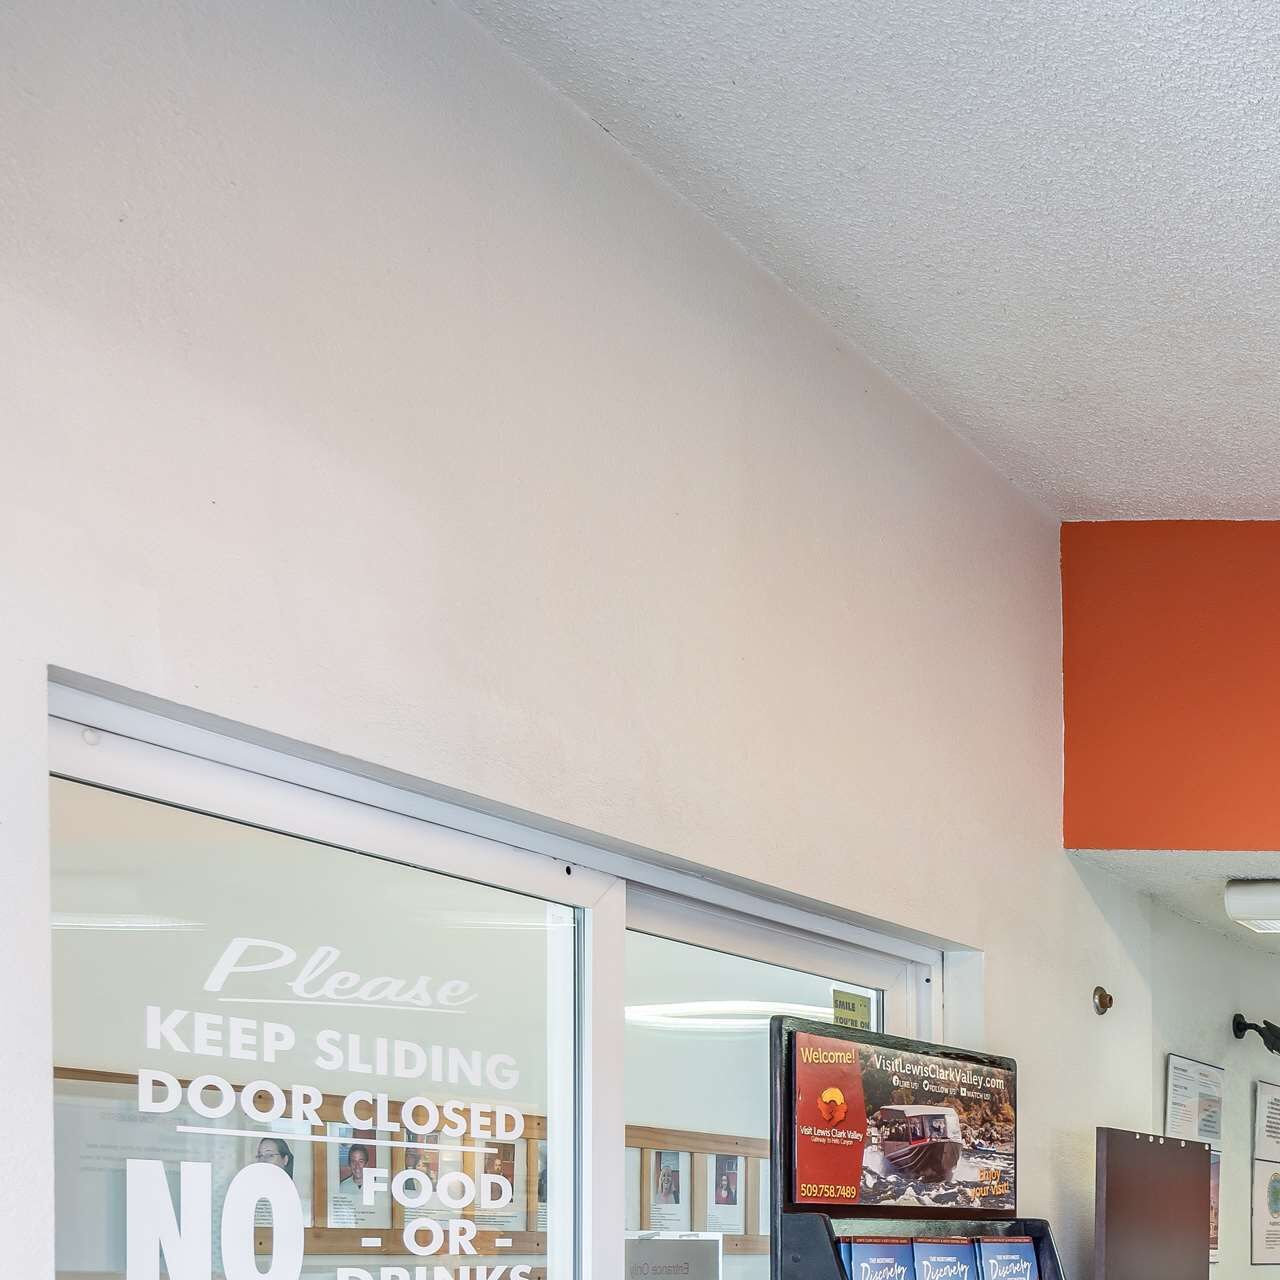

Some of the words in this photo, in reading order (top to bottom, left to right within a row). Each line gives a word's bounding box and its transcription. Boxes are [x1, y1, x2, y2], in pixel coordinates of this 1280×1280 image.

[203, 938, 478, 1006] Please
[834, 1000, 856, 1012] SMILE
[146, 1006, 296, 1064] KEEP
[315, 1030, 520, 1090] SLIDING
[800, 1047, 855, 1064] Welcome!
[874, 1055, 1005, 1090] VisitLewisClarkValley.com
[966, 1090, 982, 1099] WATCH
[138, 1069, 323, 1127] DOOR
[343, 1092, 524, 1142] CLOSED
[800, 1125, 812, 1134] Visit
[813, 1127, 830, 1137] Lewis
[831, 1129, 847, 1139] Clark
[847, 1130, 864, 1141] Valley
[978, 1168, 1001, 1184] Enjoy
[362, 1167, 514, 1209] FOOD
[800, 1183, 856, 1198] 509.758.7489
